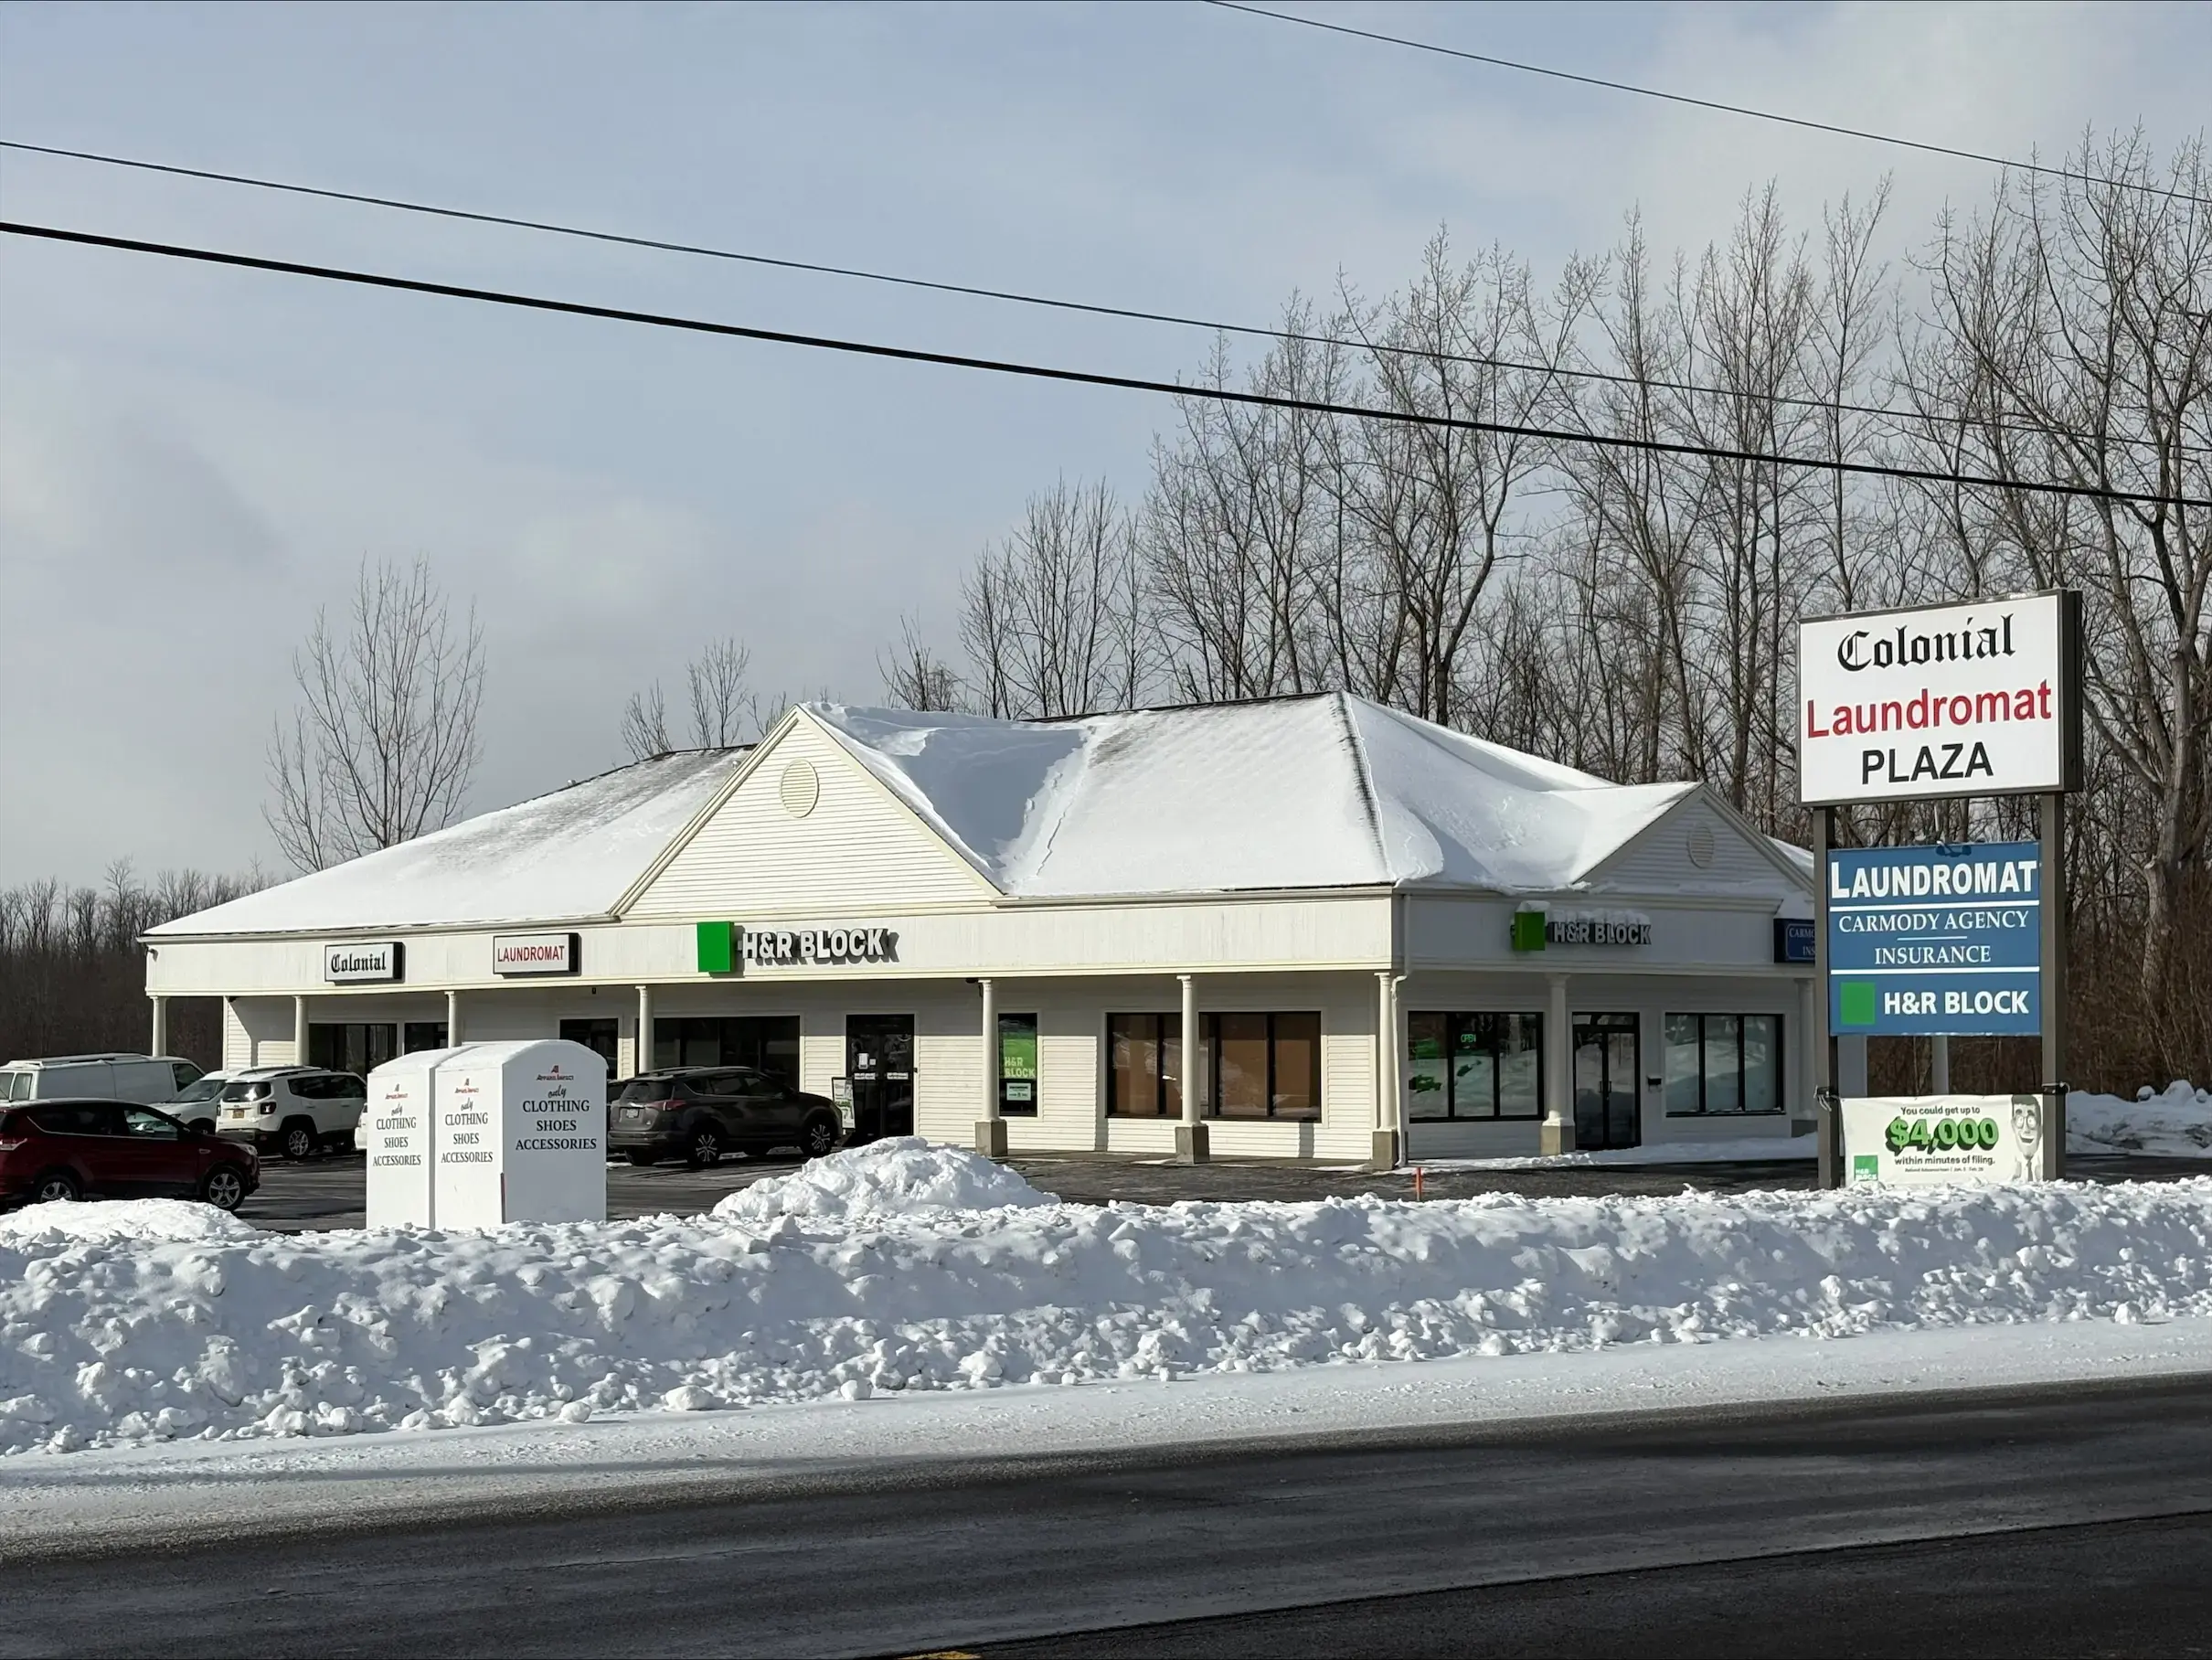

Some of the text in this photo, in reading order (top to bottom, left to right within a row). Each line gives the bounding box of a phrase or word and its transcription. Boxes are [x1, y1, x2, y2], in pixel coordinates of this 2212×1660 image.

[1837, 613, 2015, 672] Colonial
[1808, 679, 2051, 739] Laundromat
[1862, 741, 1994, 784] PLAZA
[1831, 860, 2037, 899] LAUNDROMAT
[1838, 910, 2028, 933] CARMODY AGENCY
[1554, 921, 1651, 944] H&R BLOCK
[742, 928, 886, 959] H&R BLOCK
[497, 945, 565, 963] LAUNDROMAT
[1875, 945, 1992, 965] INSURANCE
[331, 951, 387, 974] Colonial
[1884, 990, 2030, 1015] H&R BLOCK
[1005, 1056, 1024, 1067] H&R
[1005, 1068, 1036, 1078] BLOCK
[522, 1099, 590, 1112] CLOTHING
[1900, 1105, 1981, 1116] You could get up to
[376, 1117, 417, 1130] CLOTHING
[445, 1112, 488, 1126] CLOTHING
[537, 1119, 577, 1132] SHOES
[384, 1136, 409, 1148] SHOES
[453, 1133, 480, 1144] SHOES
[1886, 1116, 1999, 1155] $4,000
[516, 1138, 597, 1151] ACCESSORIES
[372, 1155, 421, 1166] ACCESSORIES
[441, 1151, 494, 1164] ACCESSORIES
[1894, 1155, 1995, 1165] within minutes of filing.
